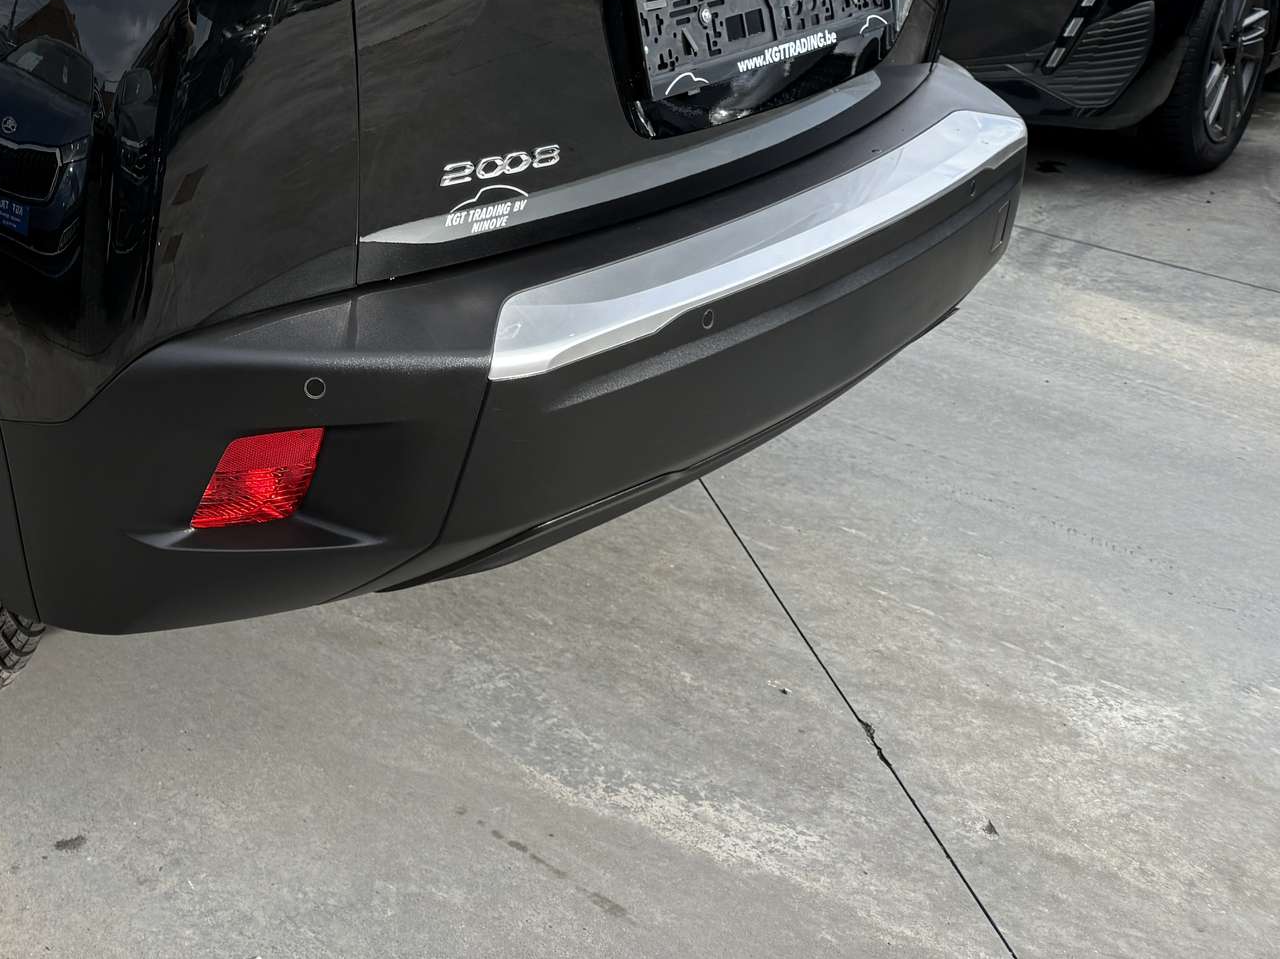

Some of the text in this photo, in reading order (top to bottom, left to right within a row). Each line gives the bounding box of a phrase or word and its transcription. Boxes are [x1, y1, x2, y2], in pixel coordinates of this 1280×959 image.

[737, 29, 837, 73] www.KGTTRADING.be
[440, 144, 560, 187] 2008
[445, 199, 528, 228] KGT TRADING BV
[471, 215, 509, 234] NINOVE
